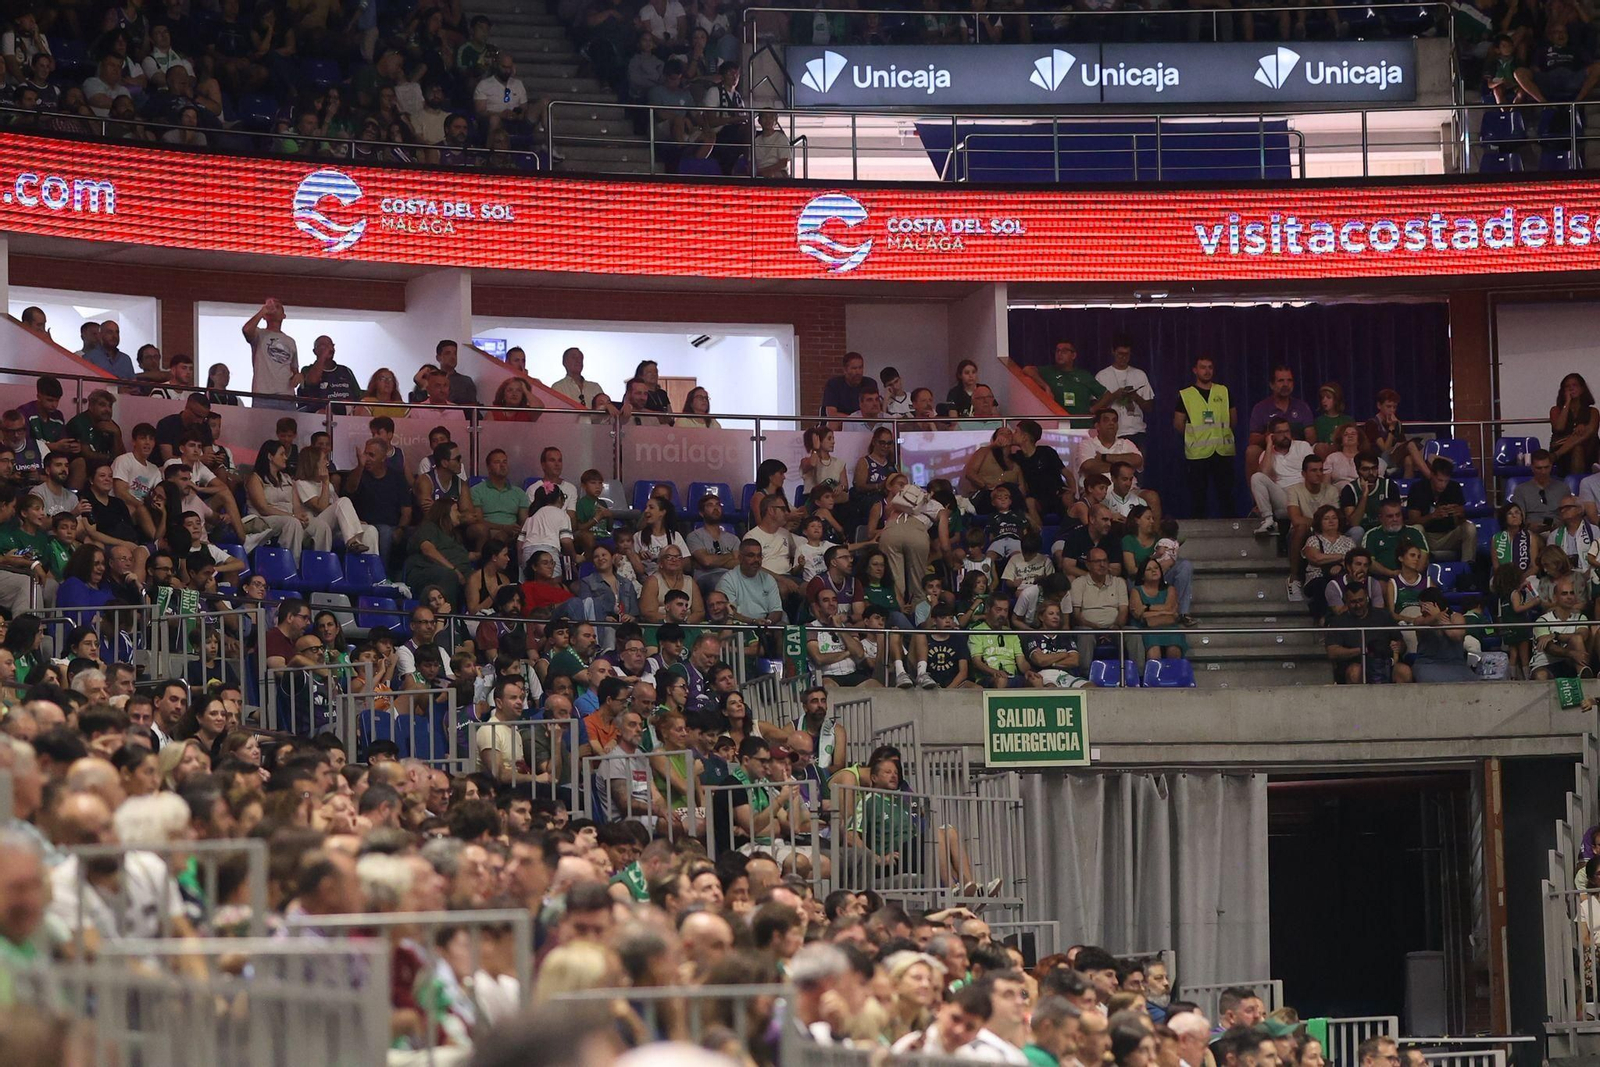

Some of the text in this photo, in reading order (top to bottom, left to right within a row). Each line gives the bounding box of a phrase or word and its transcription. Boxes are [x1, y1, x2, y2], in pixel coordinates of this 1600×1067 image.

[853, 64, 950, 94] Unicaja
[1081, 62, 1180, 92] Unicaja
[1305, 60, 1403, 90] Unicaja
[3, 173, 116, 214] .com
[381, 198, 514, 220] COSTA DEL SOL
[887, 218, 1026, 234] COSTA DEL SOL
[1194, 206, 1600, 255] visitacostadels
[996, 707, 1074, 728] SALIDA DE
[992, 731, 1080, 752] EMERGENCIA
